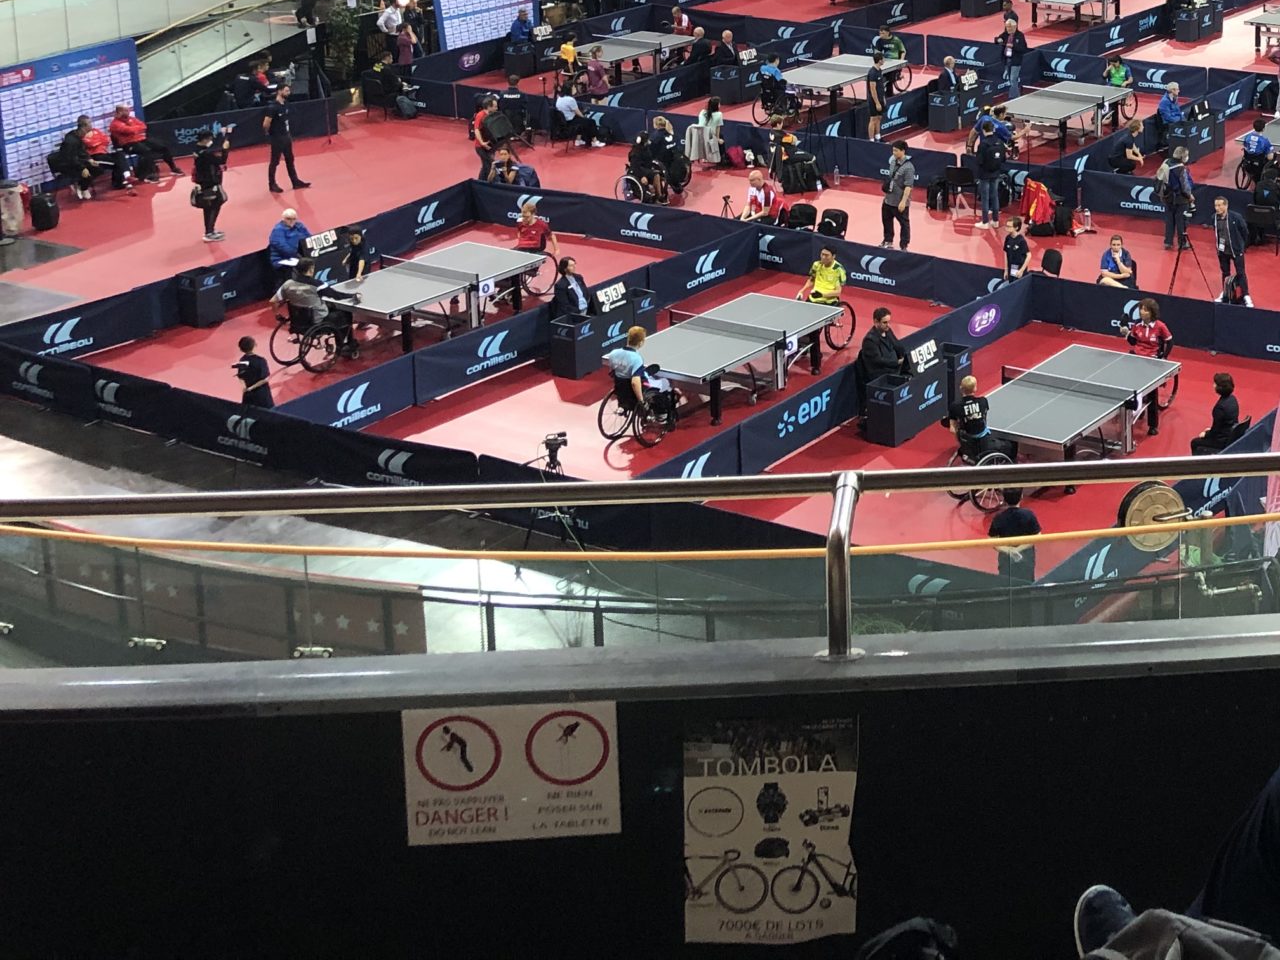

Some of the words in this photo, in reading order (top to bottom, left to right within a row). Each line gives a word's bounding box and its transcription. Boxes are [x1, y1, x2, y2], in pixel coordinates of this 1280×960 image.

[1043, 71, 1077, 80] cornilleau
[1120, 200, 1166, 213] cornilleau
[620, 227, 663, 242] cornilleau
[686, 266, 727, 290] cornilleau
[850, 271, 896, 287] cornilleau
[974, 308, 997, 332] 729
[466, 350, 518, 375] cornilleau
[963, 401, 980, 416] FIN
[217, 435, 268, 456] cornilleau
[697, 753, 838, 778] TOMBOLA
[415, 806, 499, 826] DANGER
